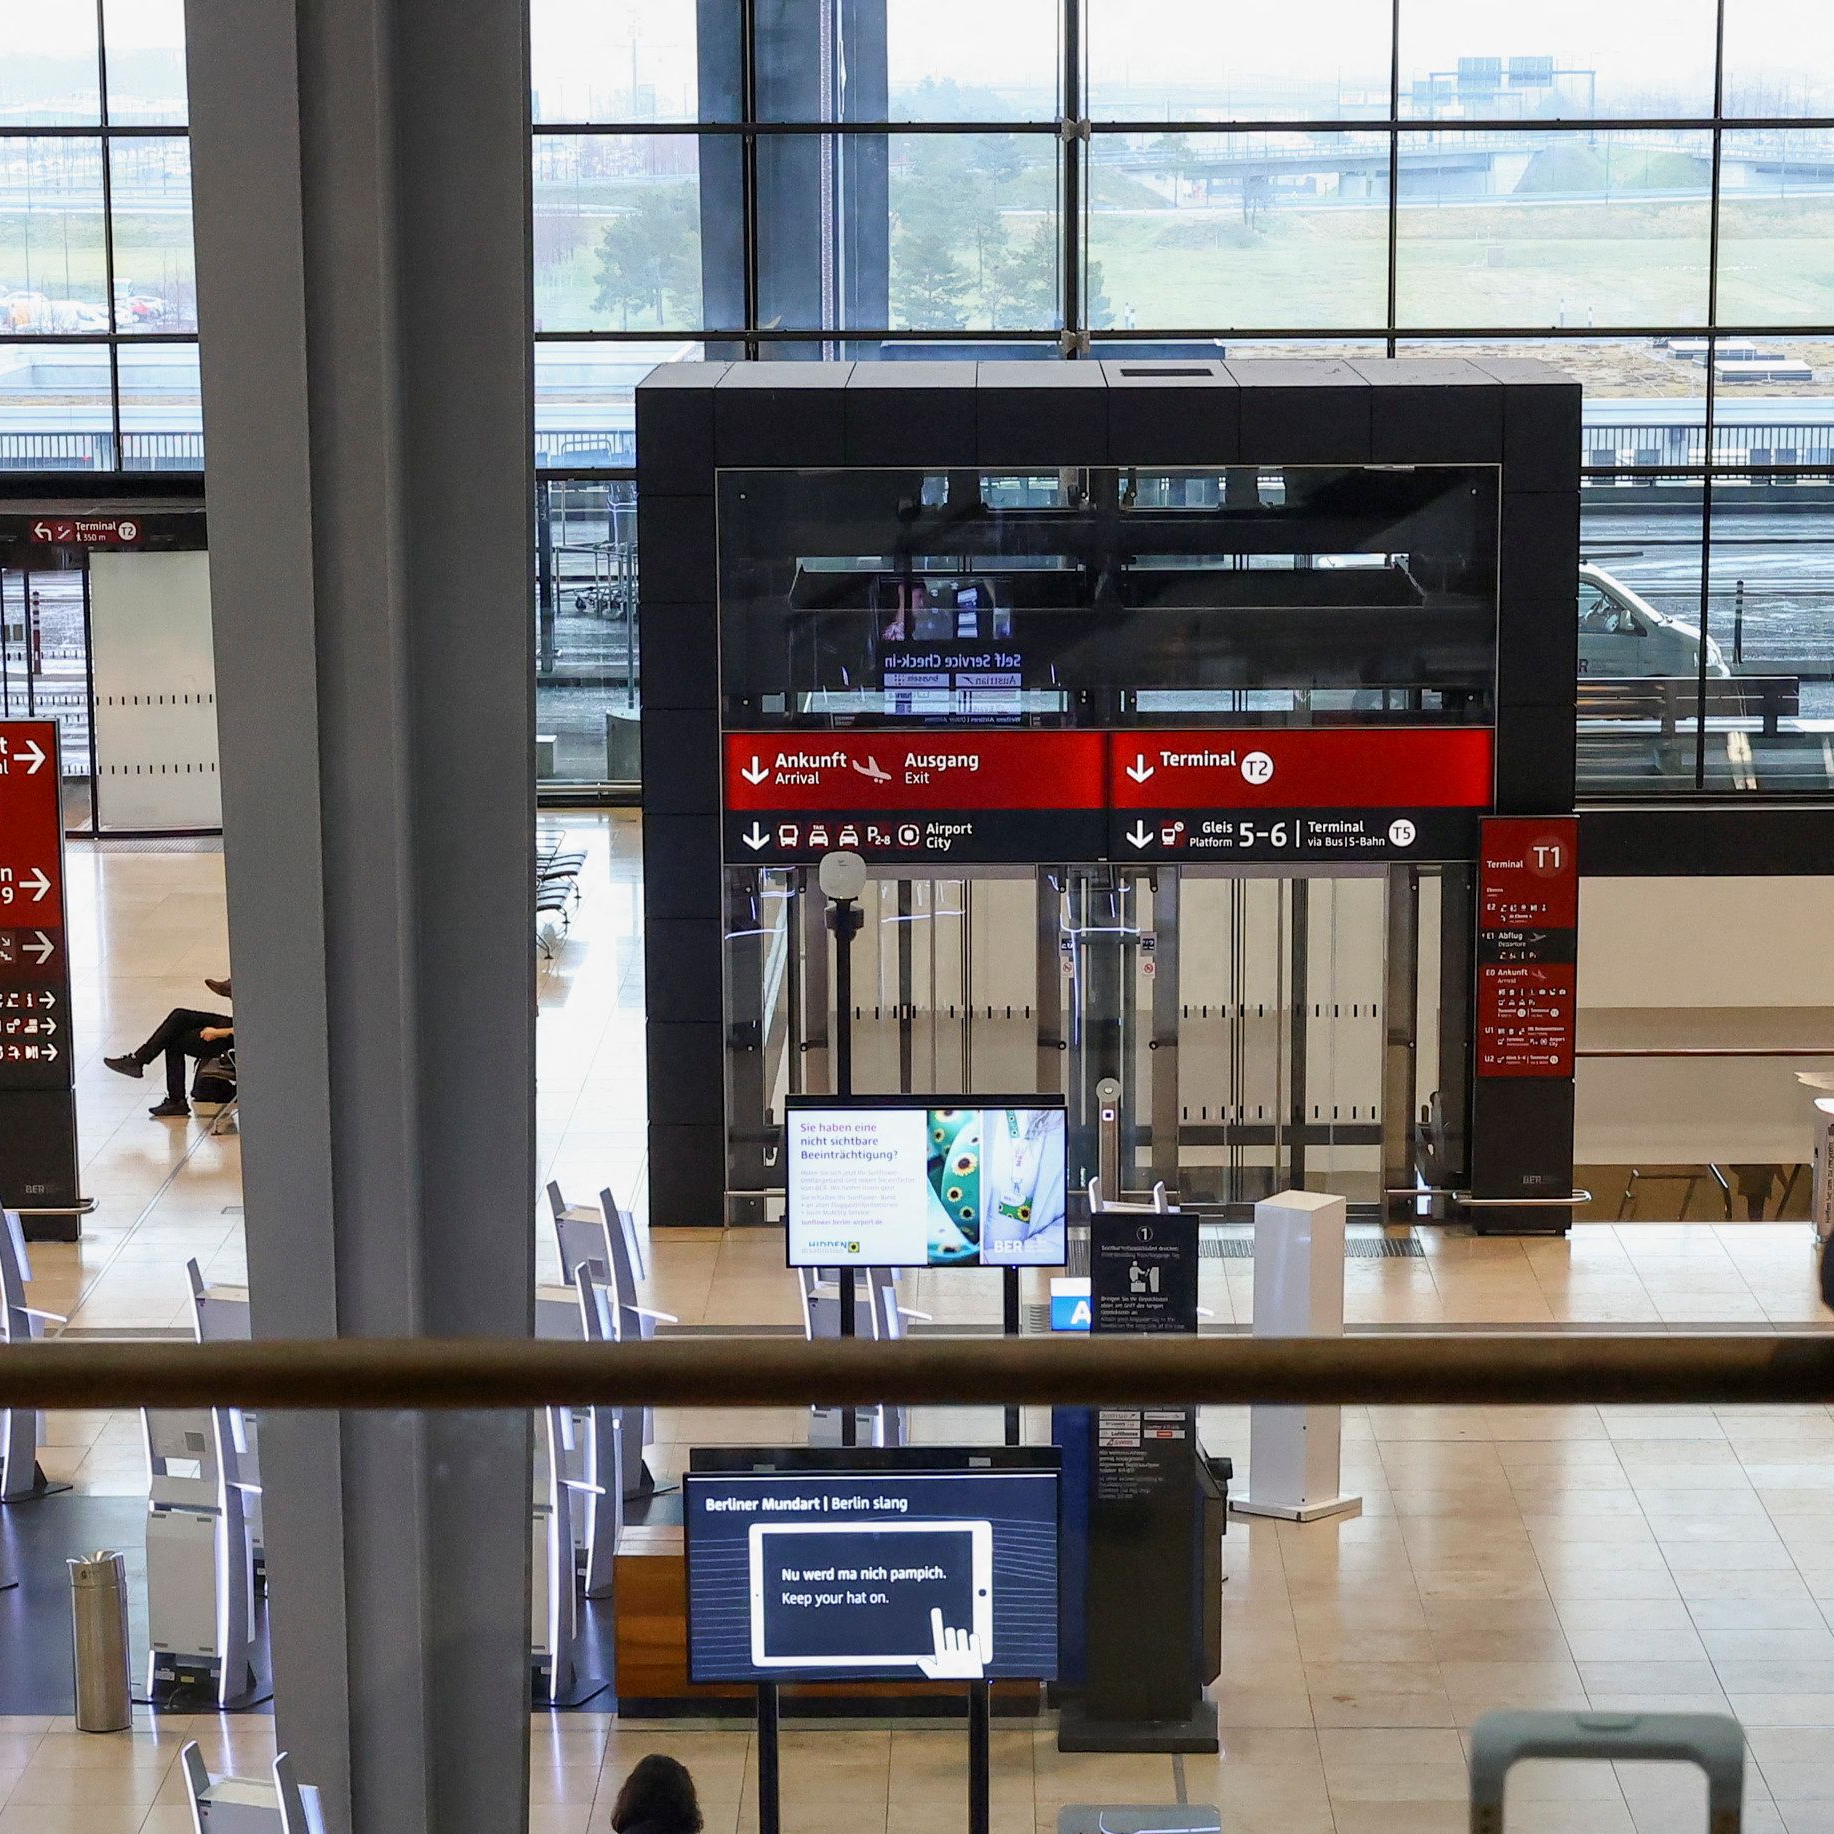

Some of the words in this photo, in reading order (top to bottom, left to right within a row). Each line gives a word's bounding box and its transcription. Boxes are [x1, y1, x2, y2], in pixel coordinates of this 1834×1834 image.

[75, 520, 116, 532] Terminal
[121, 526, 134, 536] T2
[83, 533, 96, 542] 350
[775, 752, 847, 768] Ankunft
[905, 752, 979, 771] Ausgang
[1160, 750, 1236, 767] Terminal
[1245, 760, 1268, 776] T2
[775, 771, 820, 785] Arrival
[906, 772, 929, 784] Exit
[926, 822, 972, 836] Airport
[1202, 821, 1233, 833] Gleis
[1308, 821, 1364, 833] Terminal
[1393, 826, 1411, 840] T5
[926, 836, 952, 851] City
[1189, 837, 1233, 848] Platform
[1308, 837, 1322, 847] via
[1533, 846, 1560, 868] T1
[1487, 860, 1523, 869] Terminal
[1498, 932, 1523, 940] Abflug
[800, 1122, 816, 1132] Sie
[819, 1122, 852, 1132] haben
[854, 1122, 877, 1132] eine
[800, 1136, 827, 1146] nicht
[830, 1136, 879, 1146] sichtbare
[801, 1150, 898, 1161] Beeinträchtigung?
[25, 1184, 45, 1193] BER
[705, 1498, 759, 1511] Berliner
[762, 1497, 820, 1511] Mundart
[831, 1496, 870, 1510] Berlin
[873, 1496, 908, 1513] slang
[782, 1568, 800, 1581] Nu
[803, 1566, 834, 1580] werd
[838, 1570, 857, 1580] ma
[860, 1566, 887, 1580] nich
[890, 1565, 947, 1583] pampich.
[782, 1592, 812, 1608] Keep
[815, 1594, 843, 1607] your
[846, 1591, 866, 1604] hat
[870, 1593, 890, 1604] on.
